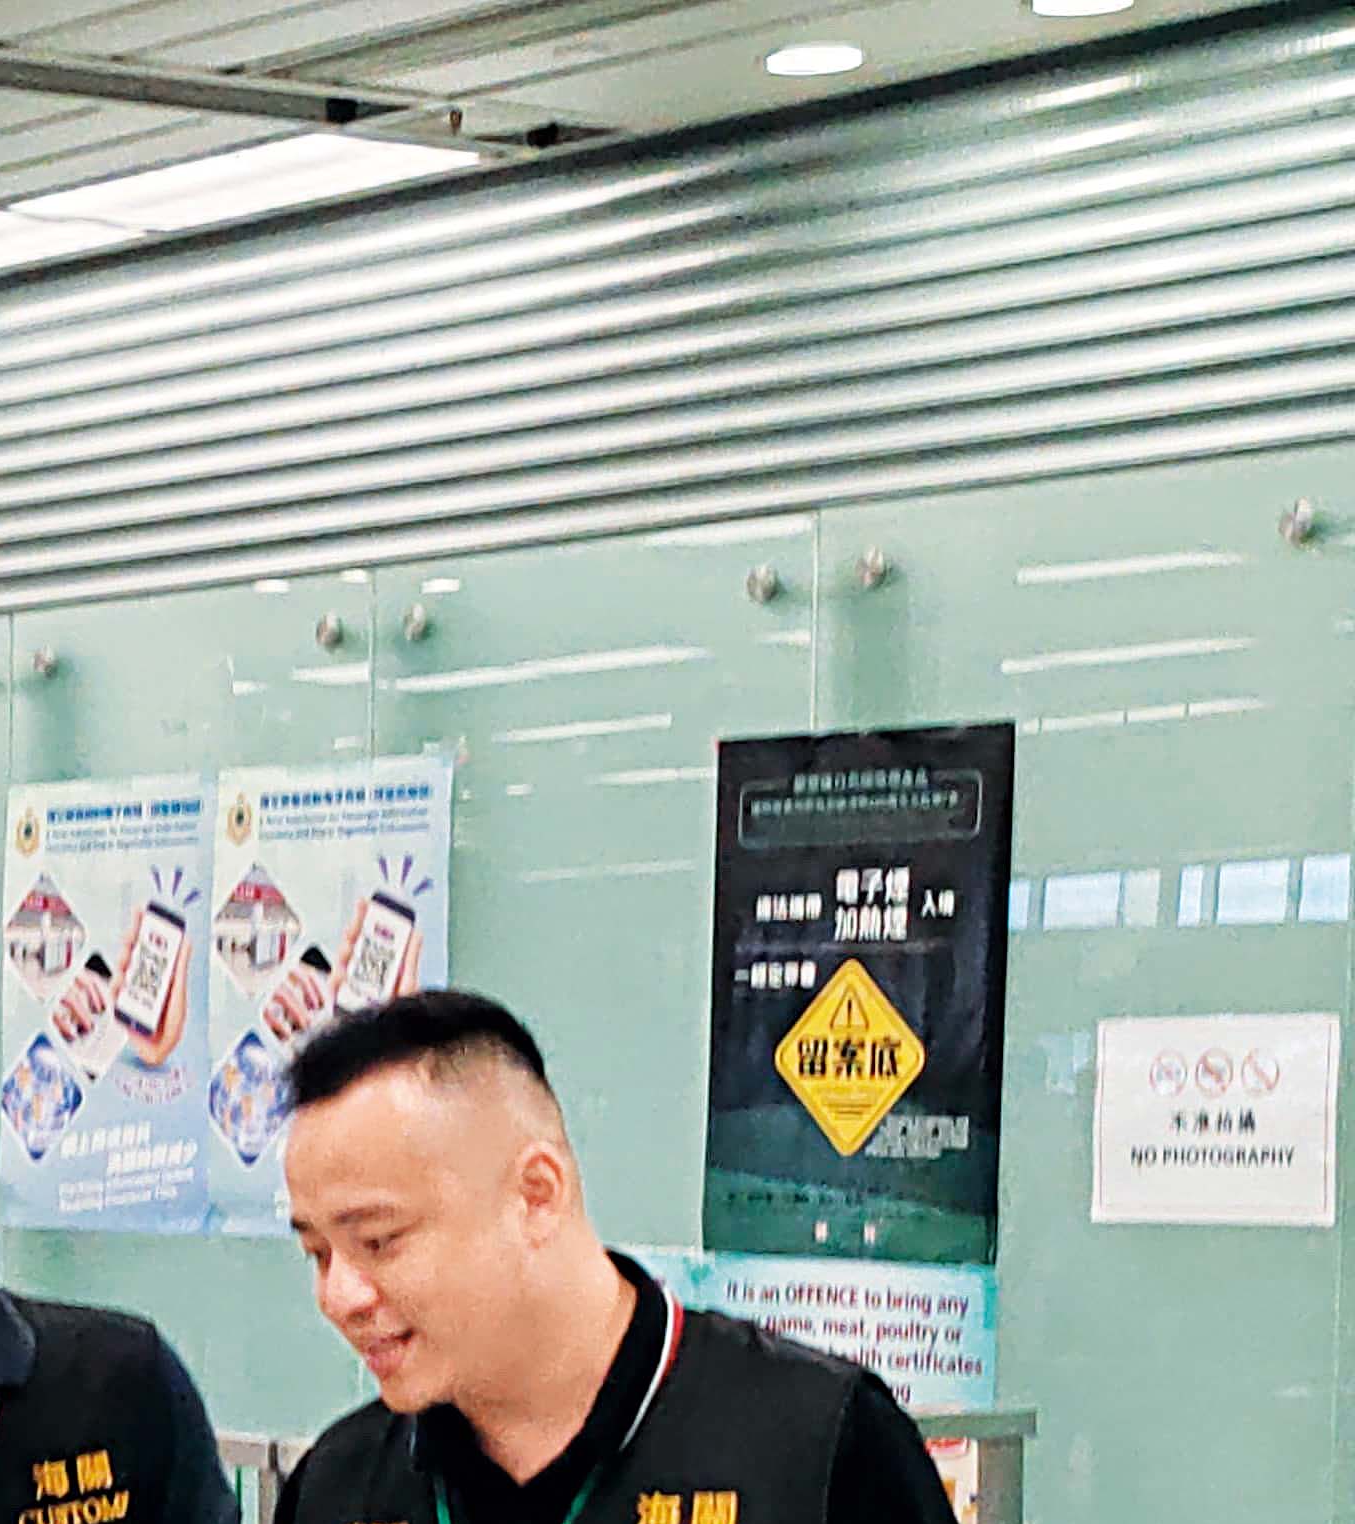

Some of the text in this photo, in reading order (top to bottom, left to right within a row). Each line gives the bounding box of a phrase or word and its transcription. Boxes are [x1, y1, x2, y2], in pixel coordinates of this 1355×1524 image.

[1131, 1145, 1295, 1168] NO PHOTOGRAPHY
[726, 1279, 738, 1302] It
[760, 1285, 781, 1306] an
[784, 1282, 858, 1307] OFFENCE
[865, 1286, 882, 1309] to
[886, 1286, 931, 1318] bring
[937, 1294, 969, 1320] any
[876, 1320, 939, 1351] poultry
[946, 1327, 962, 1345] or
[888, 1349, 983, 1375] certificates
